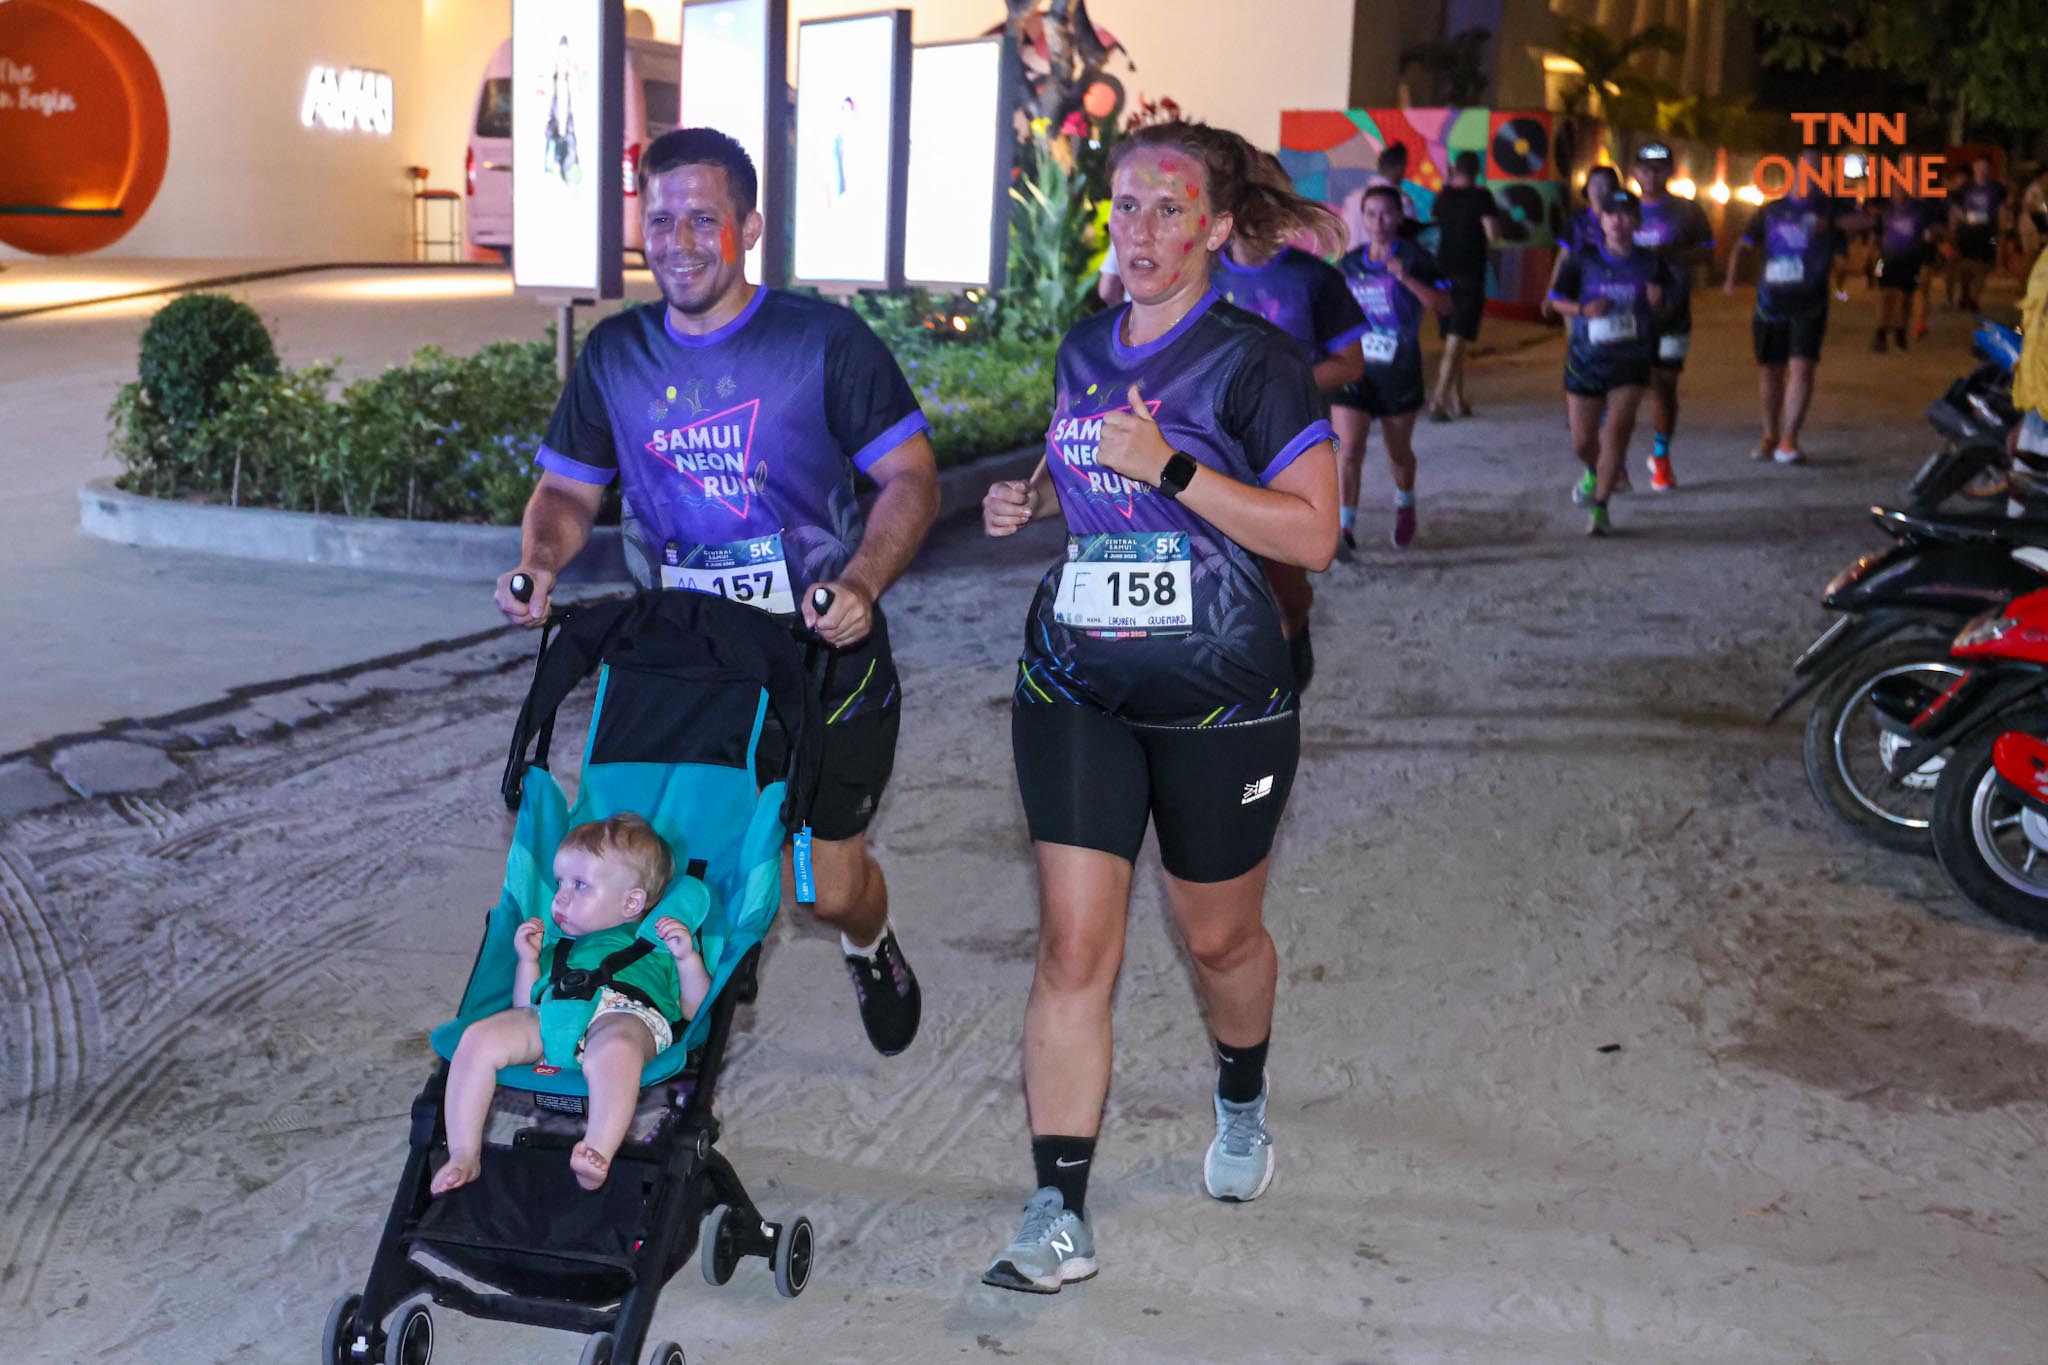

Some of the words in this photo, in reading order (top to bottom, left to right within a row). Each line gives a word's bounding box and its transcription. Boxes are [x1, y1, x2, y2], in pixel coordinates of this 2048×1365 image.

[653, 425, 741, 451] SAMUI
[1054, 418, 1103, 441] SAM
[675, 452, 744, 473] NEON
[704, 476, 758, 498] RUN
[1088, 471, 1142, 494] RUN
[750, 541, 774, 558] 5K
[1156, 538, 1181, 554] 5K
[713, 571, 773, 601] 157
[1073, 572, 1091, 603] F
[1107, 571, 1176, 607] 158
[1109, 616, 1136, 626] LAUREN
[1148, 615, 1186, 625] QUEMARD
